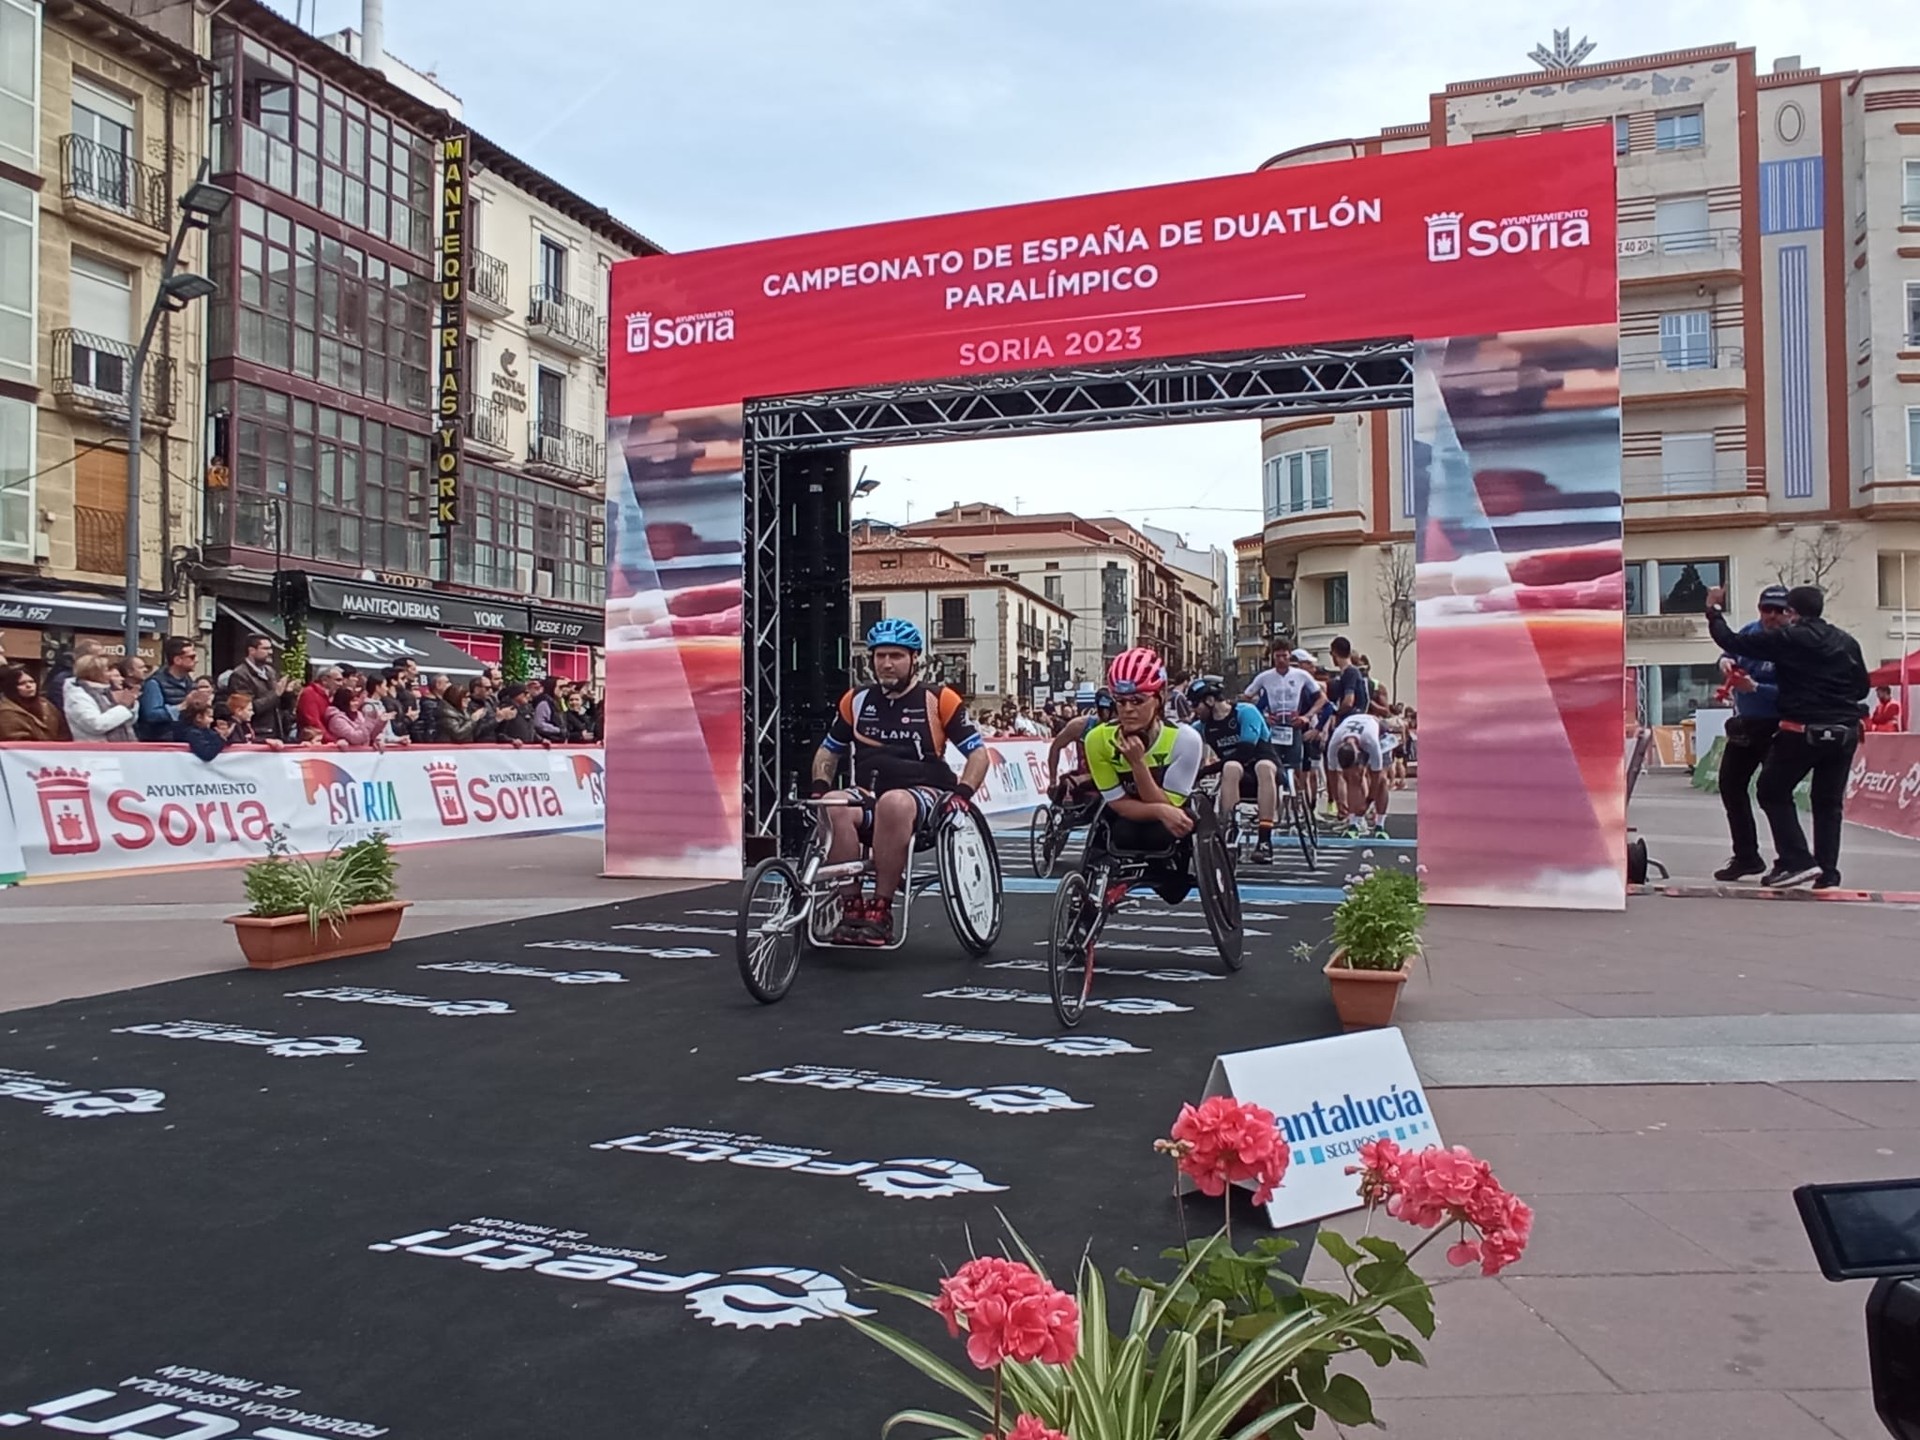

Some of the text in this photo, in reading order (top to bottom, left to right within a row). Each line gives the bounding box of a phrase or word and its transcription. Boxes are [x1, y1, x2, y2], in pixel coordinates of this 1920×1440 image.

[1500, 209, 1588, 226] AYUNTAMIENTO
[763, 195, 1381, 297] CAMPEONATO DE ESPAÑA DE DUATLÓN
[1467, 219, 1590, 257] Soria
[945, 264, 1158, 310] PARALÍMPICO
[652, 317, 734, 349] Soria
[675, 309, 734, 324] AYUNTAMIENTO
[959, 326, 1142, 366] SORIA 2023
[439, 429, 456, 521] YORK
[342, 595, 583, 636] MANTEQUERIAS YORK DESDE 1957
[146, 783, 257, 798] AYUNTAMIENTO
[488, 773, 550, 783] AYUNTAMIENTO
[107, 788, 273, 850] Soria
[467, 777, 563, 822] Soria
[1275, 1084, 1424, 1143] antalucía
[233, 1401, 389, 1438] FEDERACIÓN
